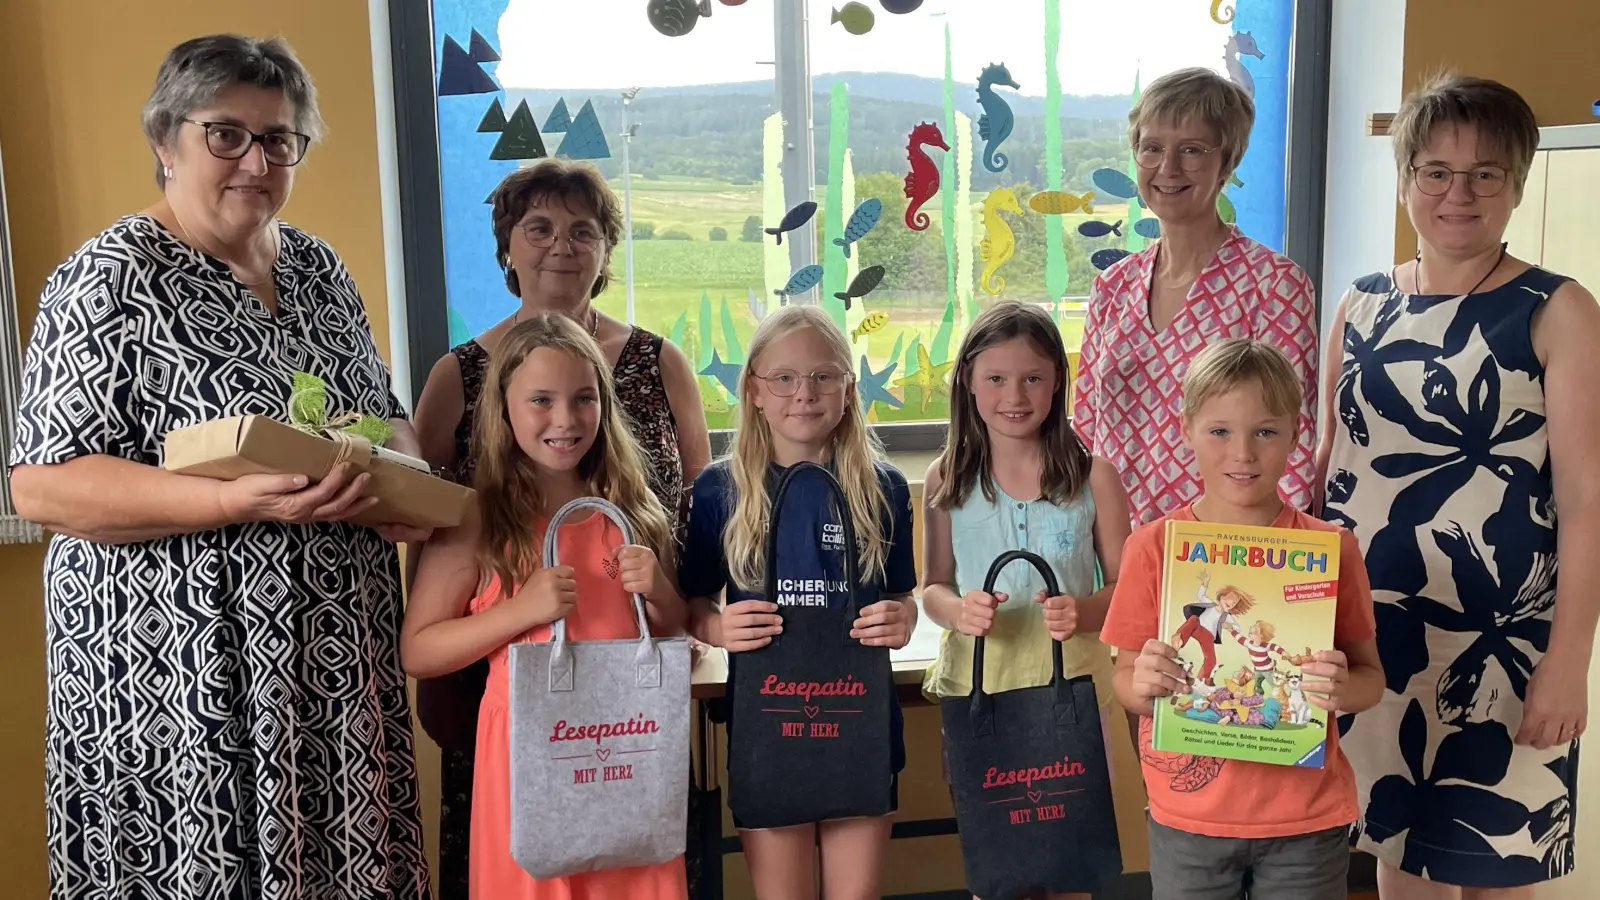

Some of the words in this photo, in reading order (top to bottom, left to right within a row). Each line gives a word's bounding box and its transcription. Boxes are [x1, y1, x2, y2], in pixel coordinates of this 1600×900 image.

[1217, 533, 1288, 545] RAVENSBURGER
[1175, 541, 1328, 573] JAHRBUCH
[777, 579, 825, 592] ICHER
[1295, 582, 1331, 592] Kindergarten
[776, 593, 826, 606] AMMER
[1297, 591, 1325, 600] Vorschule
[760, 674, 867, 702] Lesepatin
[549, 712, 660, 745] Lesepatin
[782, 722, 805, 737] MIT
[810, 723, 840, 738] HERZ
[1181, 727, 1219, 737] Geschichten,
[1220, 731, 1238, 739] Verse,
[1239, 733, 1259, 741] Bilder,
[574, 767, 597, 784] MIT
[603, 764, 633, 781] HERZ
[982, 755, 1086, 789] Lesepatin
[1009, 808, 1032, 825] MIT
[1036, 804, 1066, 821] HERZ
